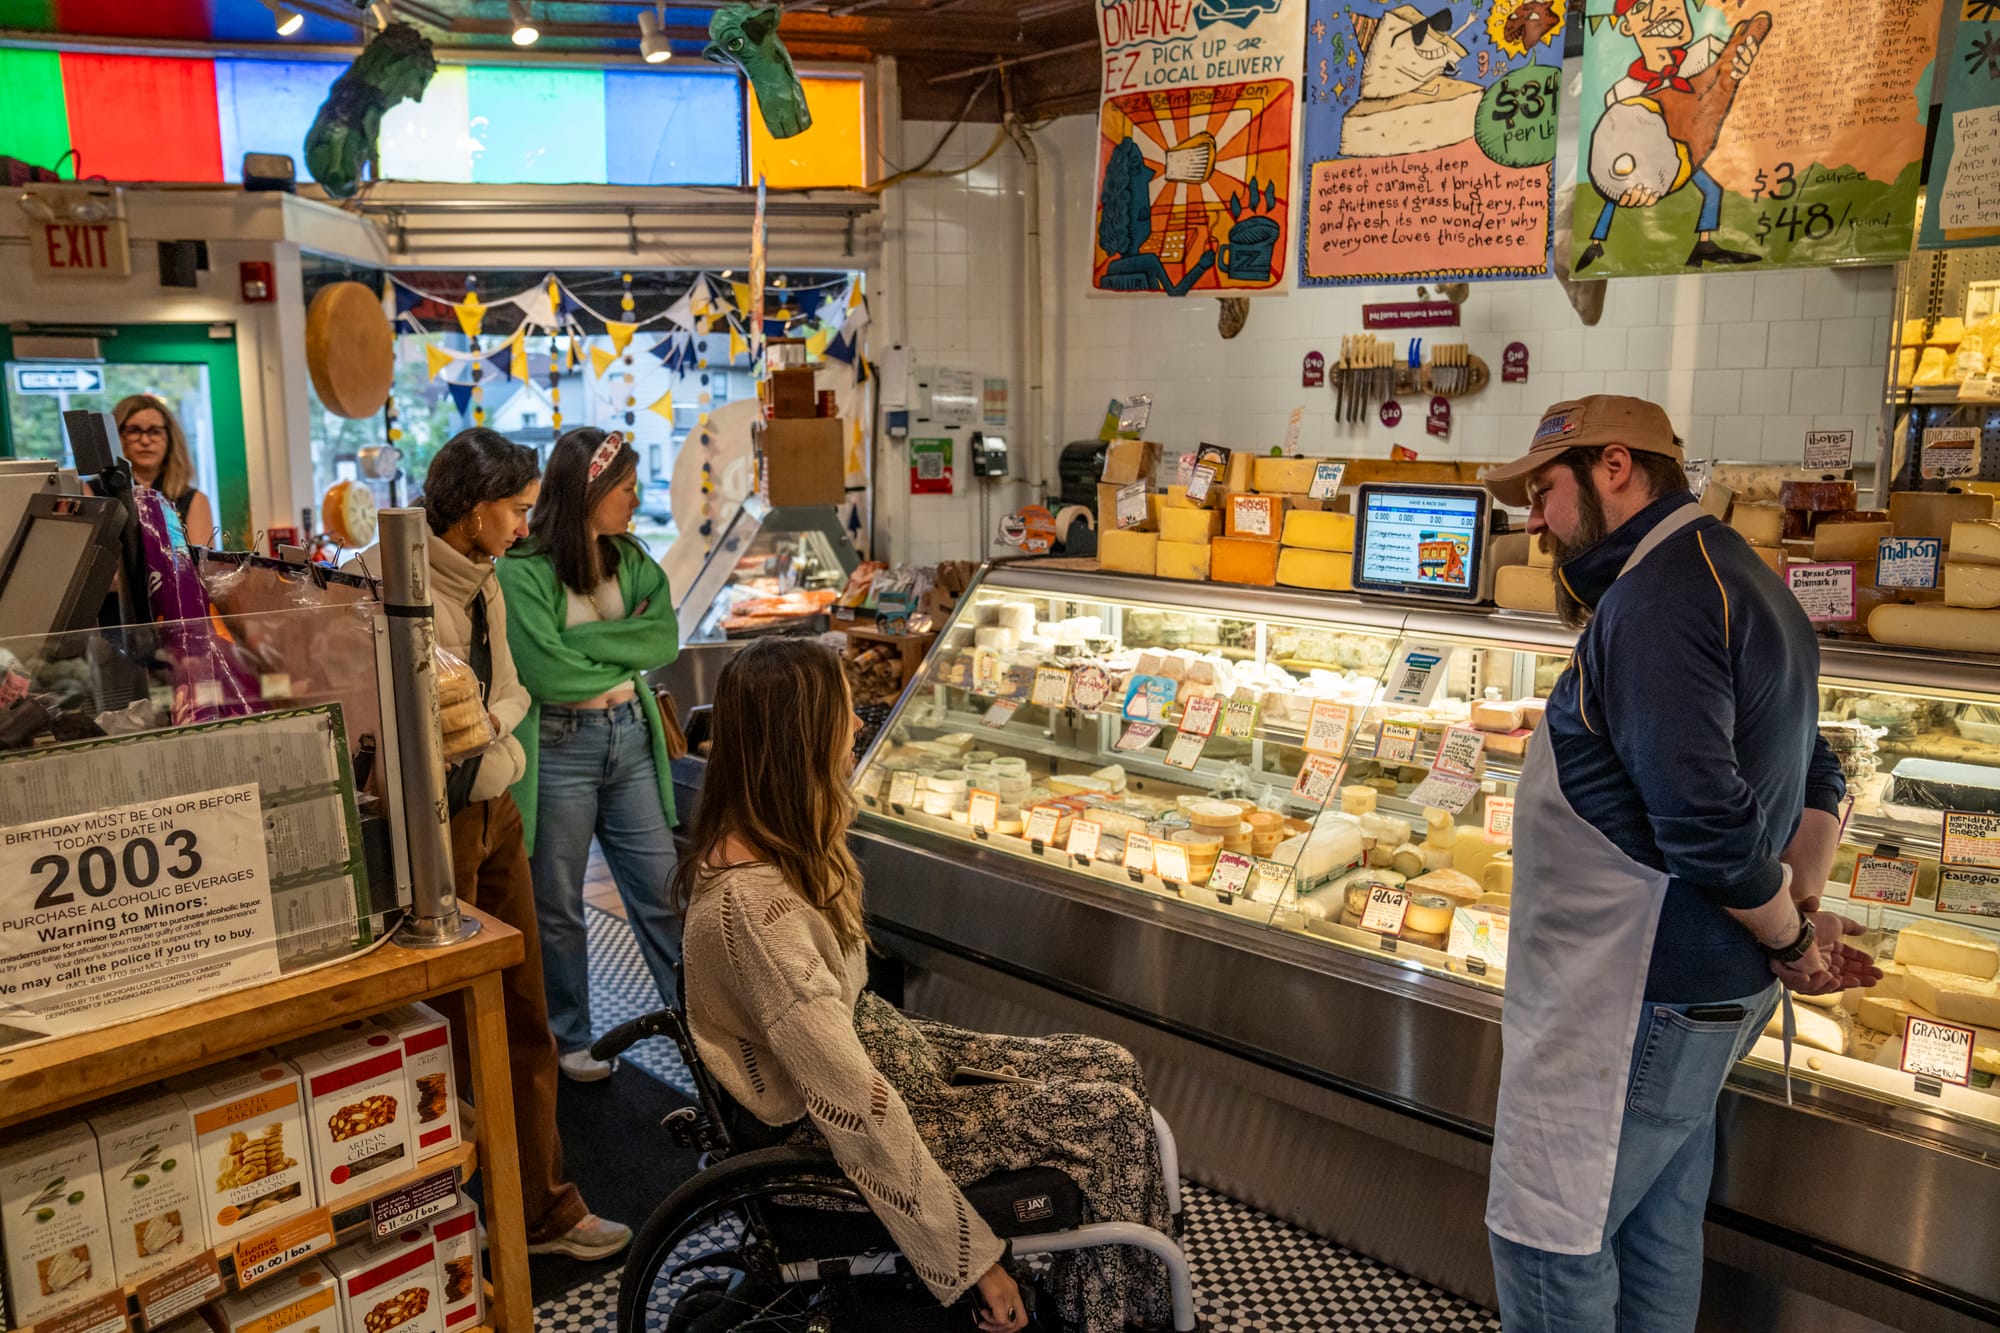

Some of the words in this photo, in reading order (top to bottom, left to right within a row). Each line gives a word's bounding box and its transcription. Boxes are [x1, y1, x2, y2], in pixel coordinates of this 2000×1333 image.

[1103, 0, 1193, 47] ONLINE!
[1152, 44, 1194, 66] PICK
[1202, 39, 1227, 59] UP
[1144, 65, 1199, 86] LOCAL
[1206, 55, 1285, 79] DELIVERY
[1492, 71, 1559, 129] $34
[1504, 126, 1536, 154] per
[1371, 159, 1398, 176] with
[1435, 158, 1469, 176] deep
[1318, 182, 1353, 197] notes
[1356, 178, 1369, 193] of
[1453, 171, 1502, 200] bright
[1506, 177, 1542, 192] notes
[1319, 200, 1333, 213] of
[1338, 197, 1400, 214] fruitiness
[1320, 213, 1344, 235] and
[1347, 211, 1390, 230] fresh
[1395, 213, 1413, 226] its
[1420, 215, 1437, 226] no
[1442, 212, 1506, 231] wonder
[1510, 211, 1538, 231] why
[45, 224, 109, 268] EXIT
[1323, 234, 1389, 257] everyone
[1438, 229, 1466, 246] this
[6, 822, 81, 845] BIRTHDAY
[85, 812, 125, 832] MUST
[130, 809, 147, 822] BE
[152, 805, 173, 819] ON
[176, 801, 196, 815] OR
[200, 791, 253, 810] BEFORE
[54, 832, 117, 852] TODAY'S
[121, 823, 157, 839] DATE
[161, 820, 174, 831] IN
[1949, 828, 1986, 838] cheese
[30, 829, 203, 910] 2003
[2, 904, 87, 932] PURCHASE
[91, 887, 171, 913] ALCOHOLIC
[175, 868, 255, 895] BEVERAGES
[1, 945, 61, 964] misdemeanor
[63, 941, 75, 950] for
[83, 934, 107, 945] minor
[119, 923, 158, 937] ATTEMPT
[169, 911, 205, 927] purchase
[206, 904, 239, 917] alcoholic
[240, 899, 262, 910] liquor.
[37, 916, 116, 943] Warning
[121, 912, 139, 924] to
[144, 896, 208, 919] Minors:
[6, 965, 17, 974] try
[19, 959, 41, 970] using
[42, 955, 61, 964] false
[63, 943, 110, 960] identification
[111, 940, 126, 949] you
[126, 936, 143, 945] may
[155, 927, 174, 938] guilty
[183, 919, 210, 931] another
[211, 908, 257, 924] misdemeanor
[53, 961, 73, 970] Your
[73, 953, 101, 967] driver's
[102, 947, 128, 960] license
[130, 941, 150, 952] could
[21, 976, 52, 991] may
[56, 968, 81, 982] call
[85, 962, 107, 976] the
[111, 953, 151, 970] police
[155, 948, 163, 958] if
[167, 943, 191, 957] you
[194, 938, 211, 949] try
[214, 933, 226, 943] to
[230, 927, 255, 940] buy.
[129, 965, 144, 975] and
[146, 961, 163, 970] MCL
[103, 986, 136, 998] MICHIGAN
[136, 979, 161, 991] LIQUOR
[161, 972, 191, 984] CONTROL
[192, 961, 231, 976] COMMISSION
[45, 1004, 91, 1020] DEPARTMENT
[104, 990, 139, 1006] LICENSING
[139, 988, 153, 997] AND
[154, 977, 196, 993] REGULATORY
[196, 970, 221, 982] AFFAIRS
[1912, 1022, 1969, 1047] GRAYSON
[348, 1131, 386, 1151] ARTISAN
[348, 1141, 387, 1161] CRISPS
[377, 1202, 411, 1221] crisps
[1027, 1197, 1047, 1211] JAY
[240, 1244, 279, 1267] coins
